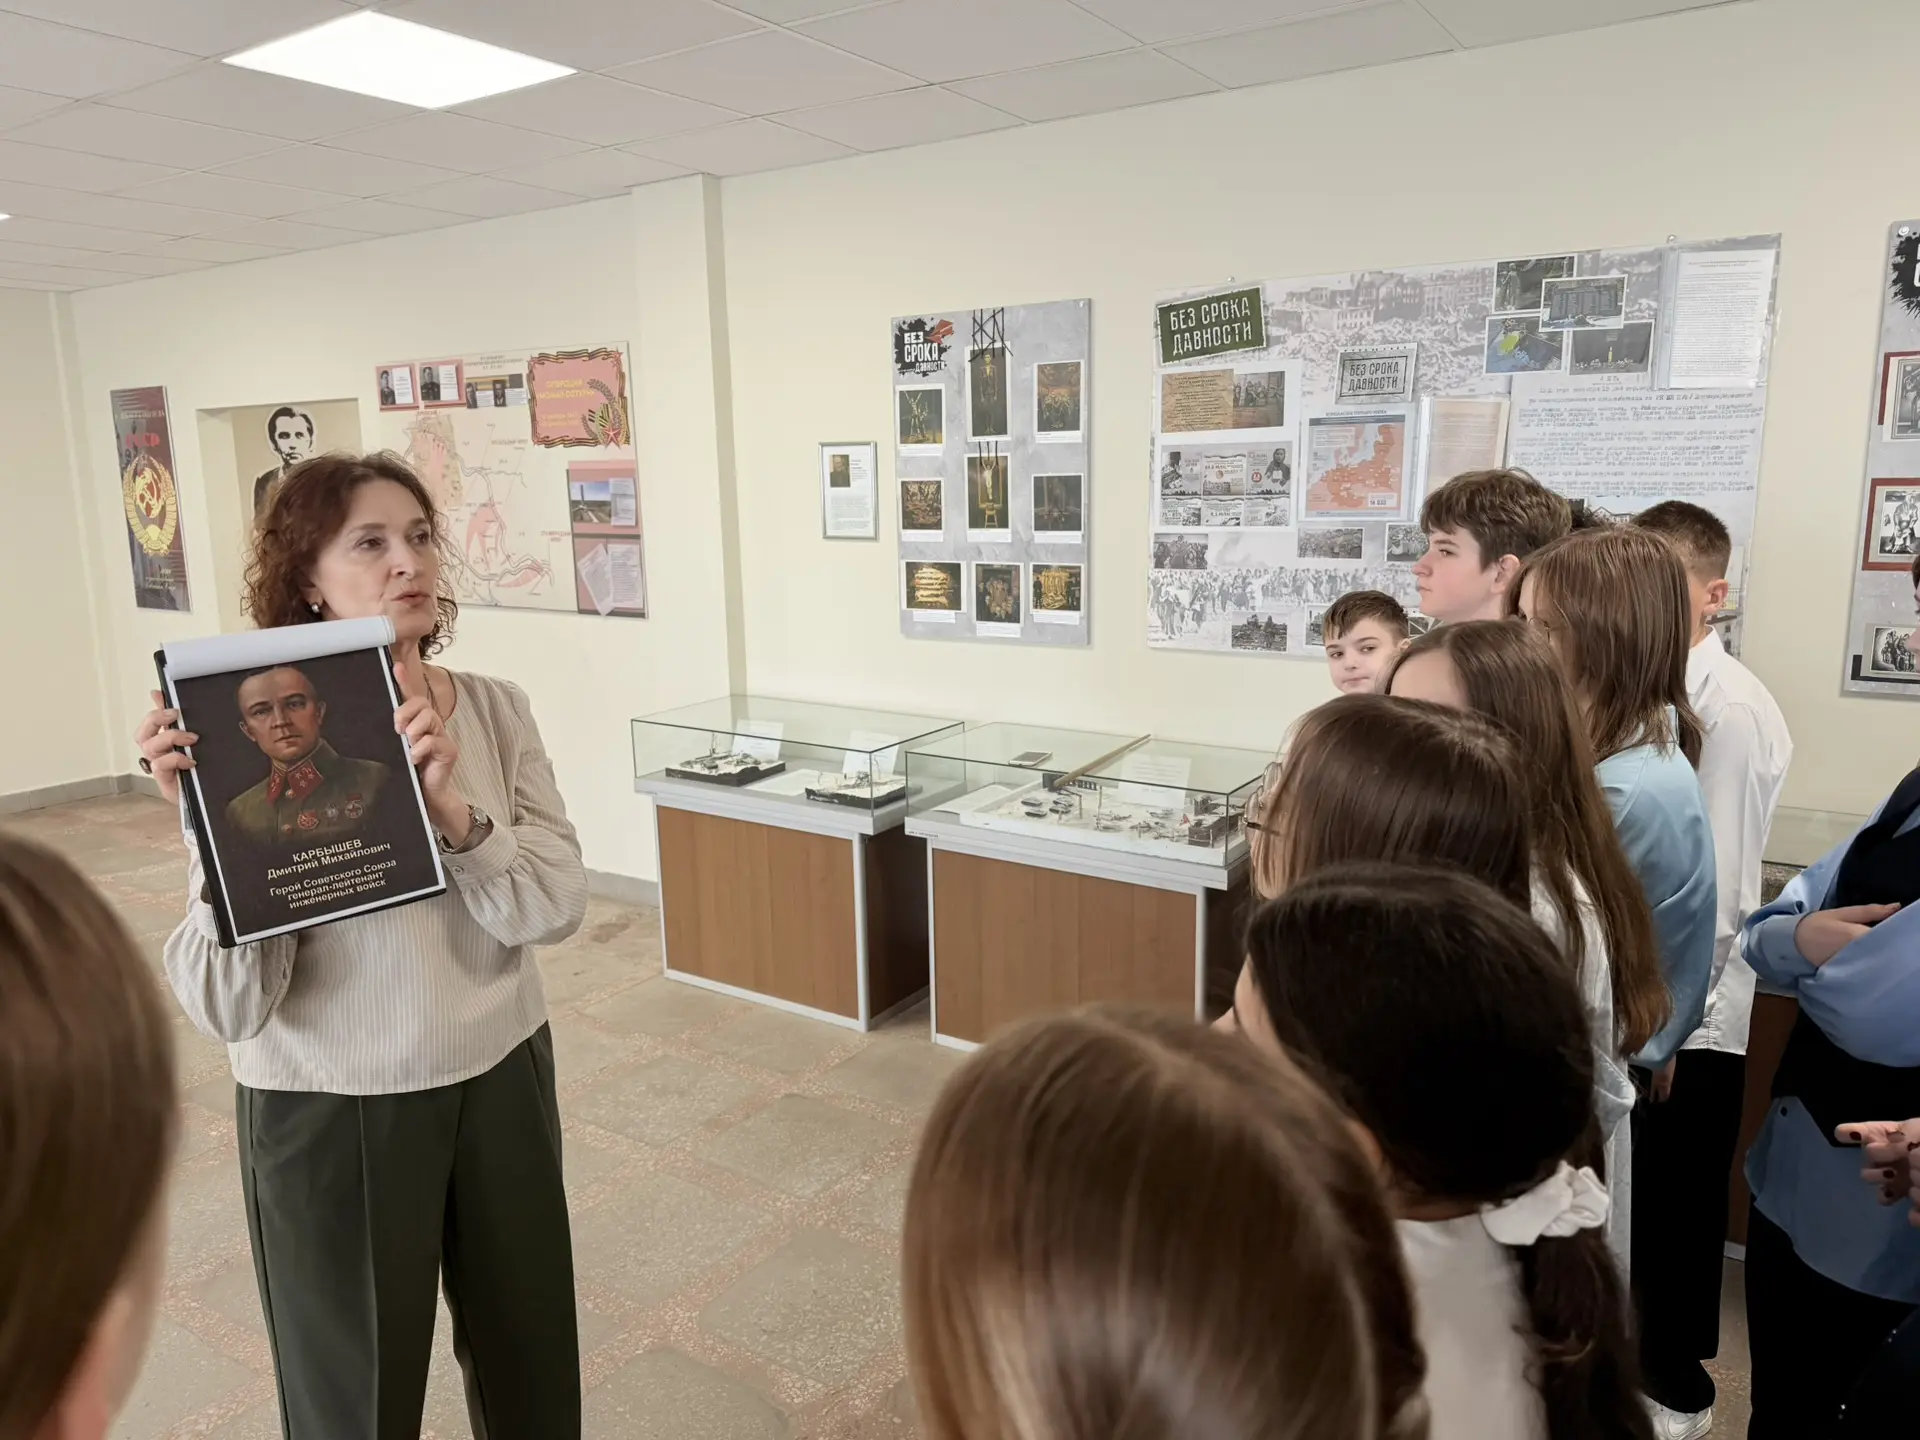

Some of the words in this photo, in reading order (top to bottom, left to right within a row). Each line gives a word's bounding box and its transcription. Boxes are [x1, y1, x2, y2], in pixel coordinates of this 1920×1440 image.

[1170, 308, 1196, 331] БЕЗ
[1201, 297, 1251, 324] СРОКА
[904, 331, 923, 344] БЕЗ
[904, 342, 939, 362] СРОКА
[1173, 321, 1252, 356] ДАВНОСТИ
[1349, 363, 1366, 376] БЕЗ
[1369, 361, 1399, 375] СРОКА
[1348, 377, 1398, 392] ДАВНОСТИ
[267, 860, 319, 880] Дмитрий
[321, 842, 391, 866] Михайлович
[292, 839, 362, 862] КАРБЫШЕВ
[269, 881, 302, 897] Герой
[303, 869, 362, 888] Советского
[363, 859, 397, 873] Союза
[288, 871, 384, 901] генерал-лейтенант
[289, 888, 355, 909] инженерных
[356, 879, 387, 892] войск
